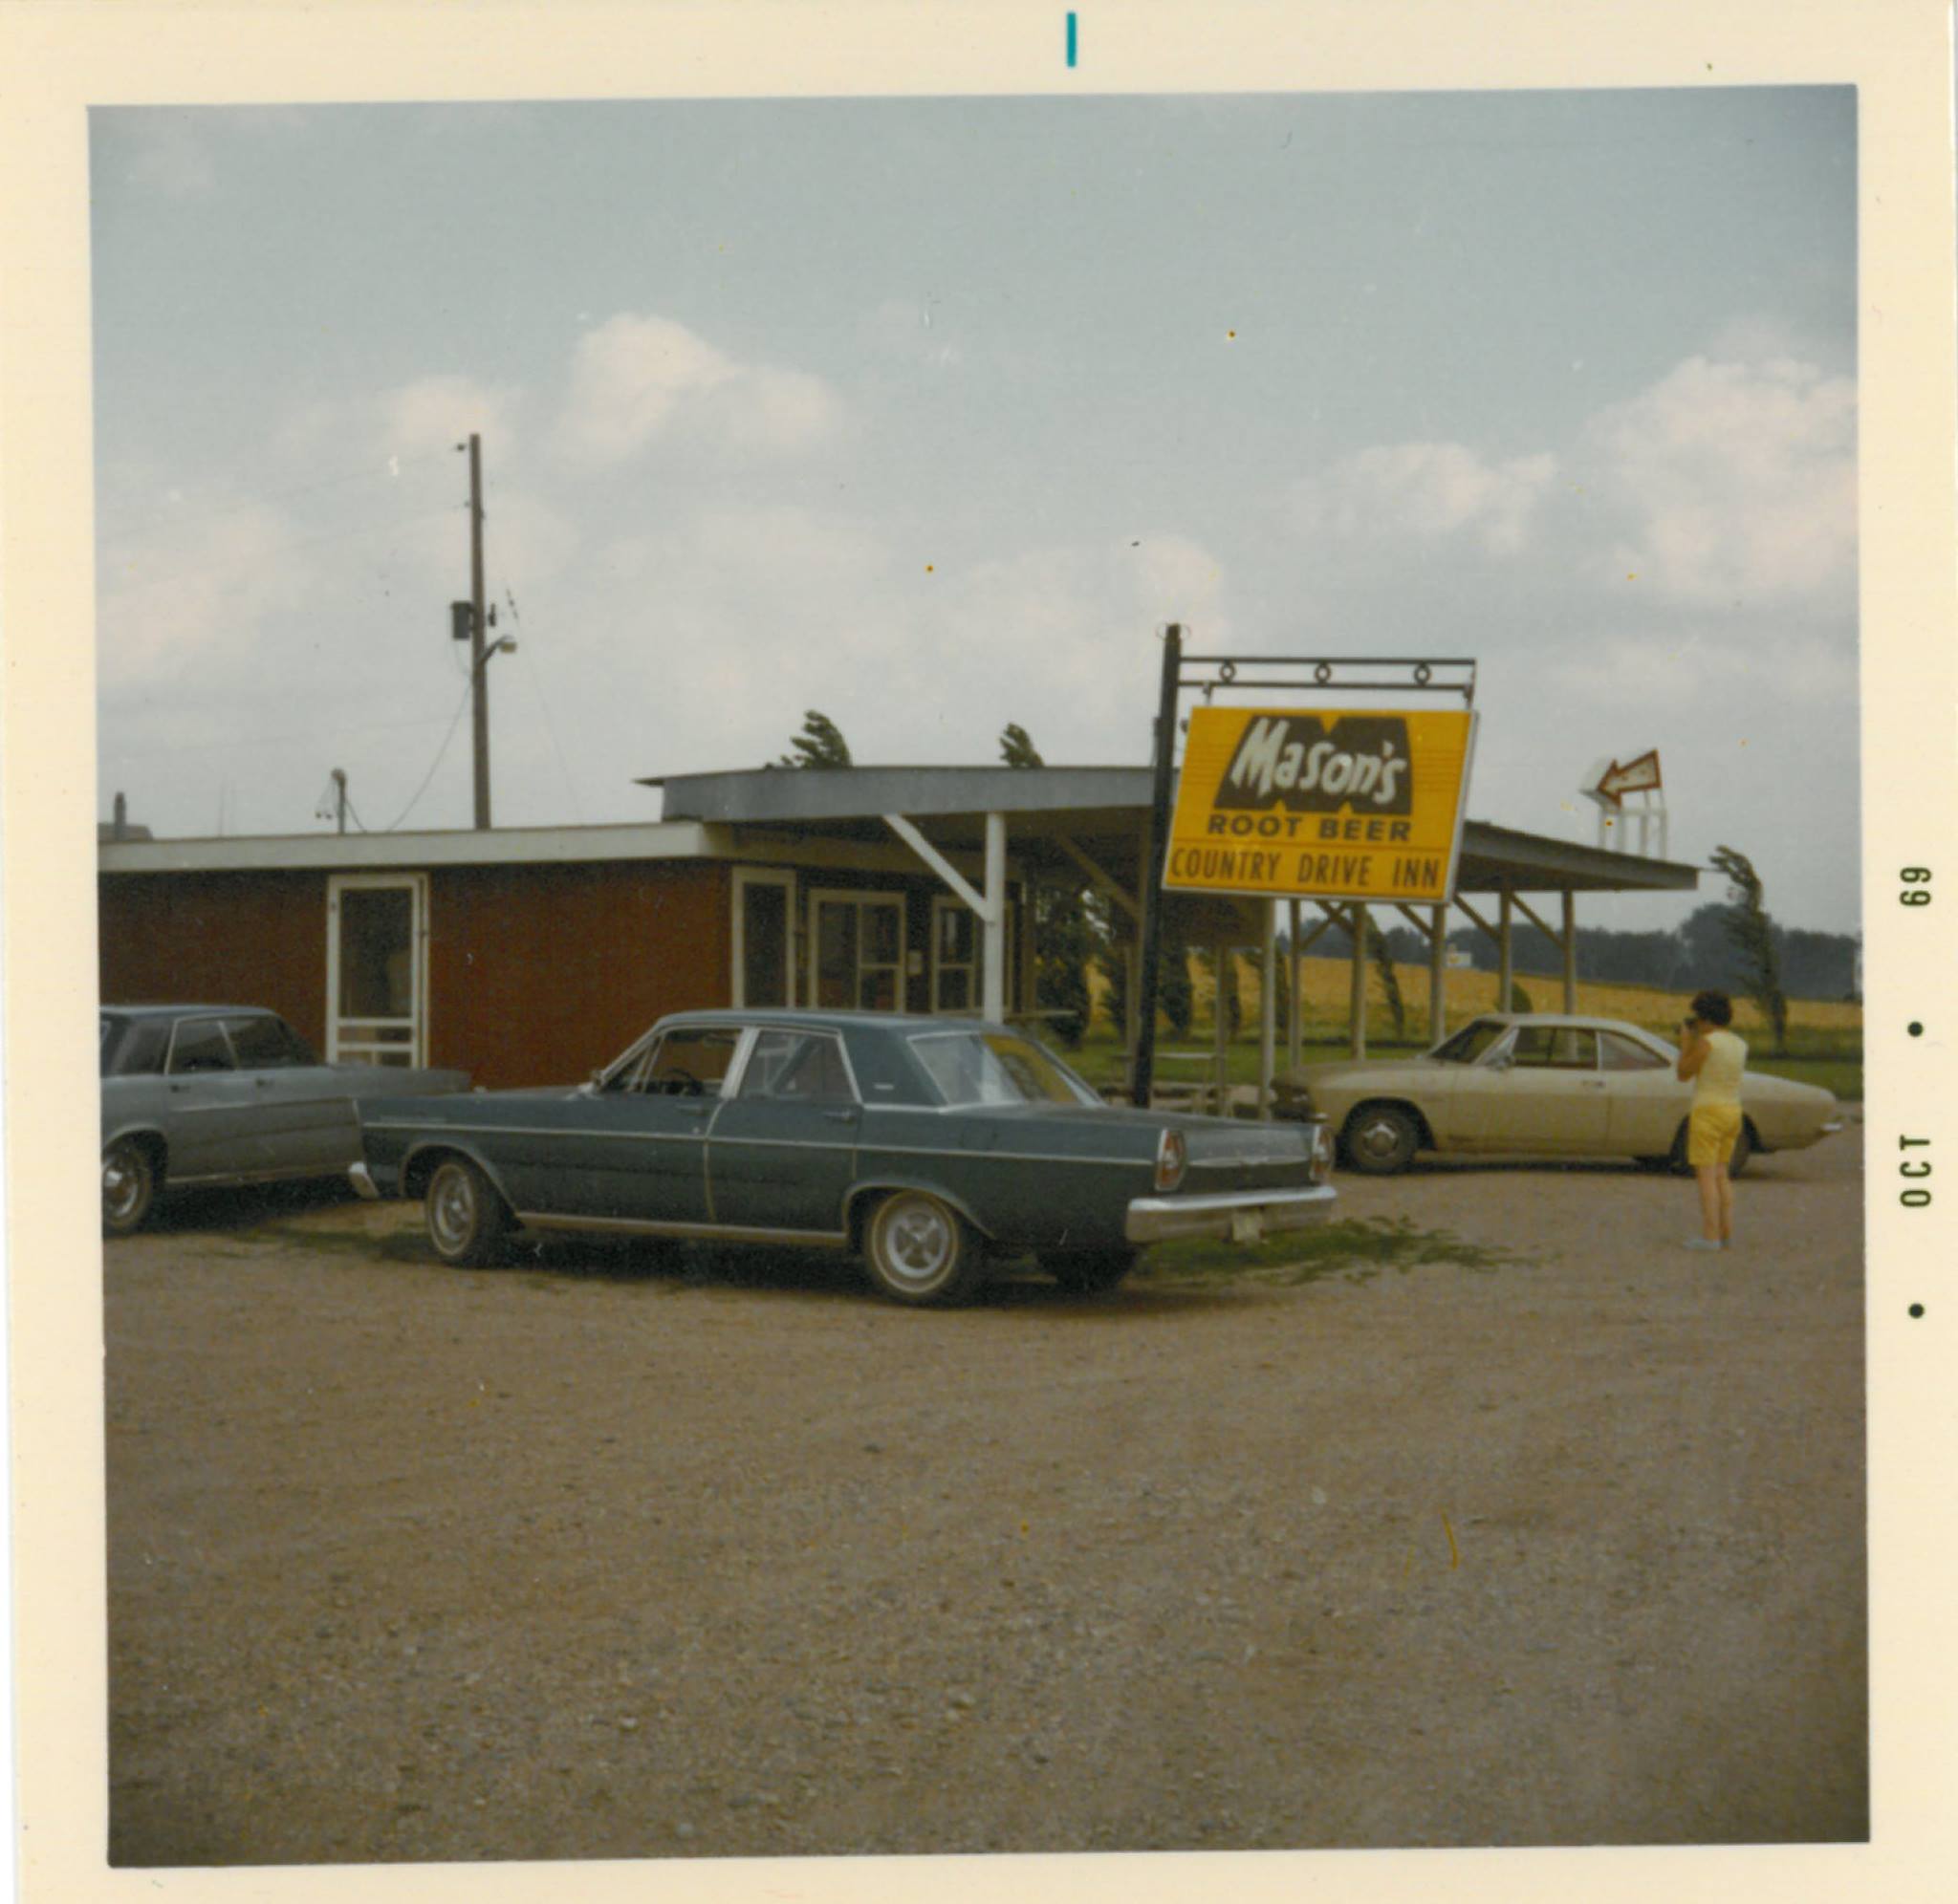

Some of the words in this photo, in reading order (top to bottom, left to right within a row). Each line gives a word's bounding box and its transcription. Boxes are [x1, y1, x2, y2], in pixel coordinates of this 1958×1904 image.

[1229, 717, 1407, 804] Mason's
[1207, 814, 1301, 837] ROOT
[1318, 818, 1411, 842] BEER
[1171, 848, 1282, 880] COUNTRY
[1297, 855, 1374, 887] DRIVE
[1392, 857, 1440, 889] INN
